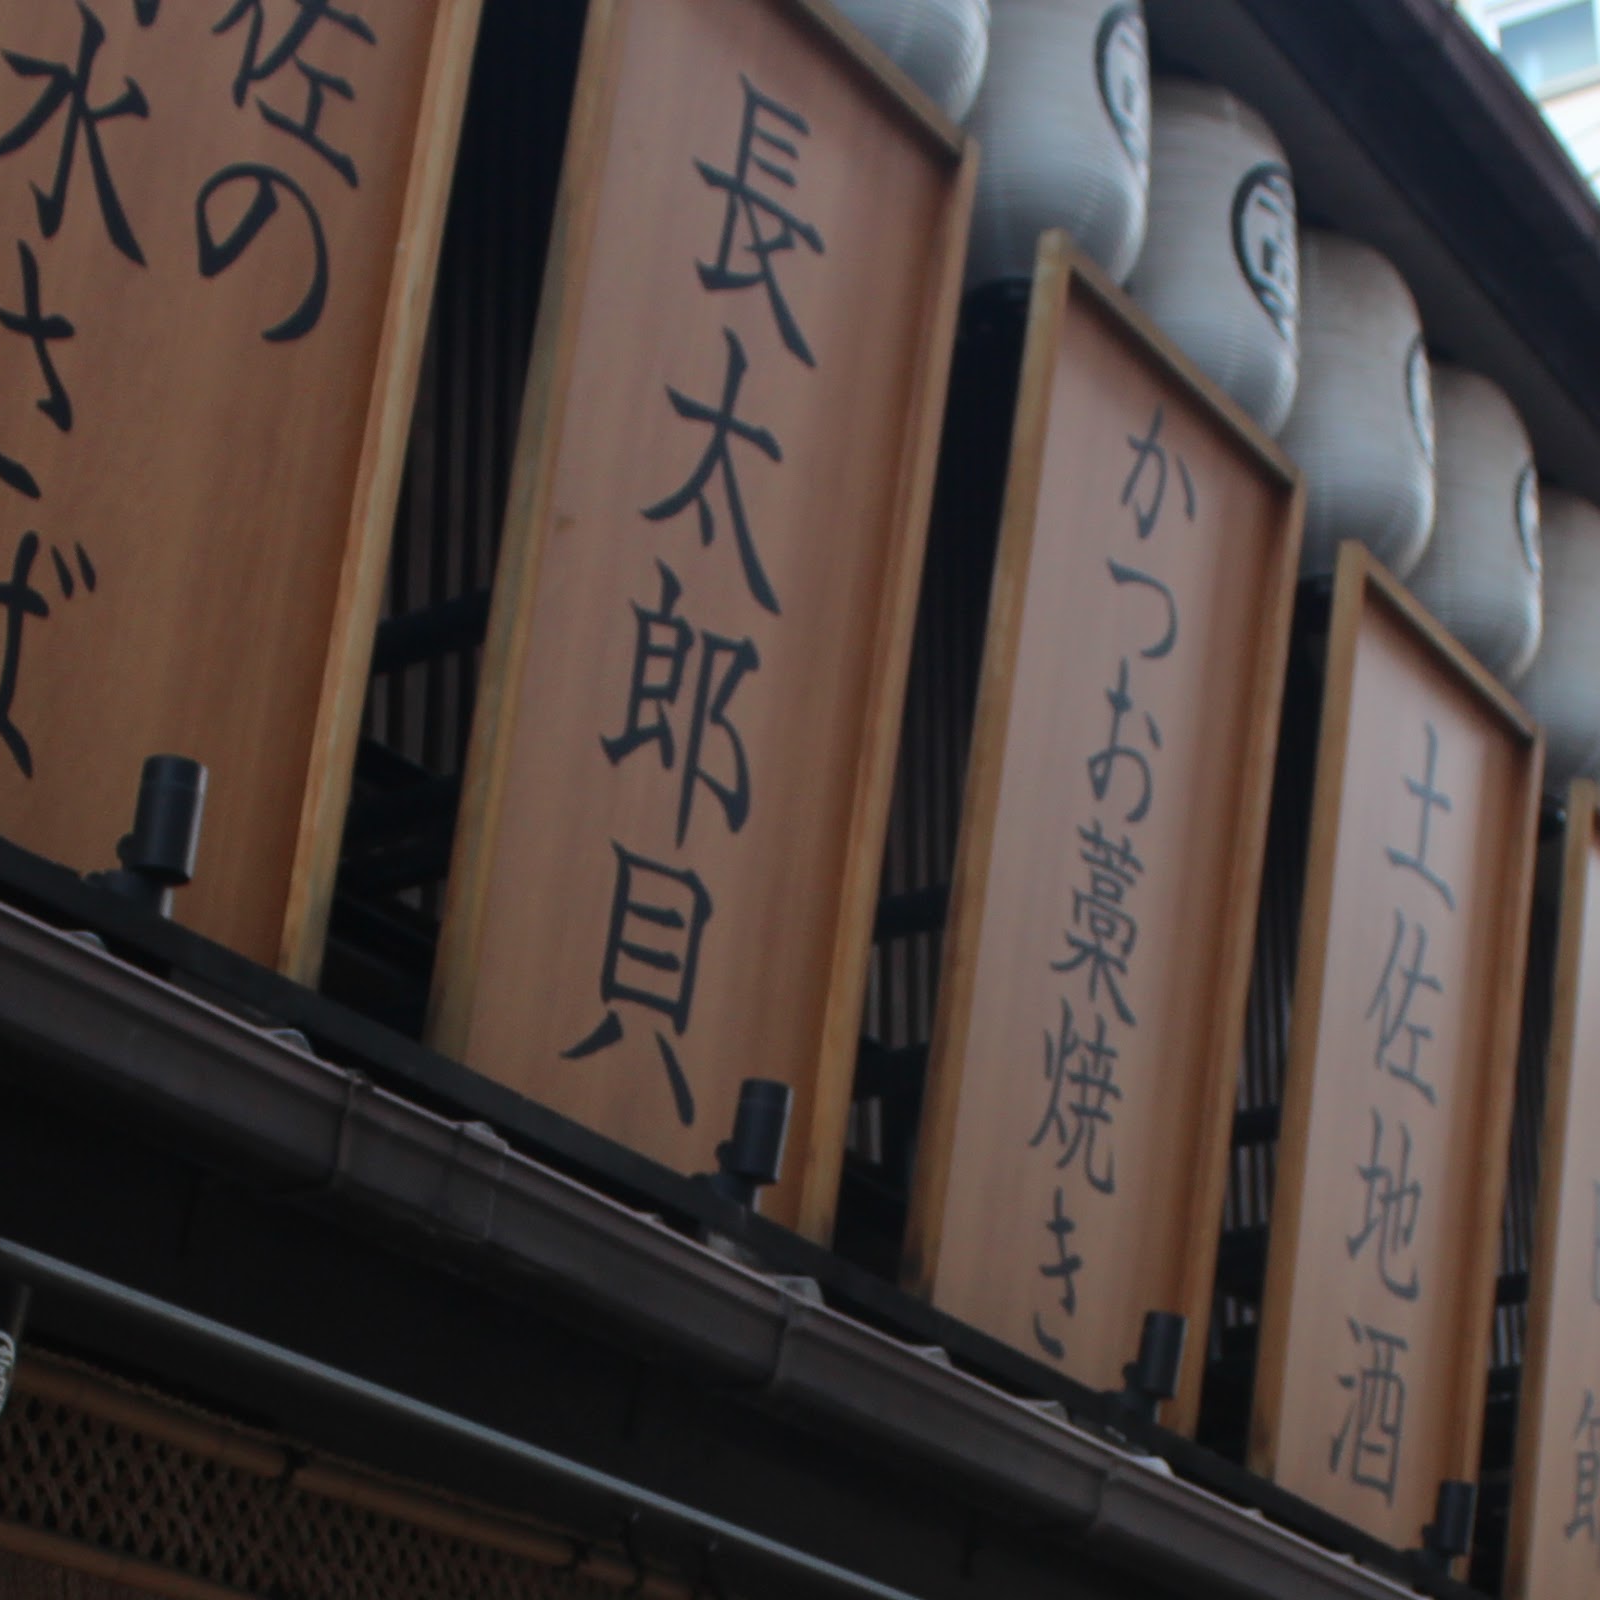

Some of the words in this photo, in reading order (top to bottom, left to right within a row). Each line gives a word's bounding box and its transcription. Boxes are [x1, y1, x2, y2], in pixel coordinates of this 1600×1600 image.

[559, 73, 827, 1127] 長太郎貝
[1029, 404, 1197, 1360] かつお藁焼き
[1330, 721, 1458, 1510] 土佐地酒
